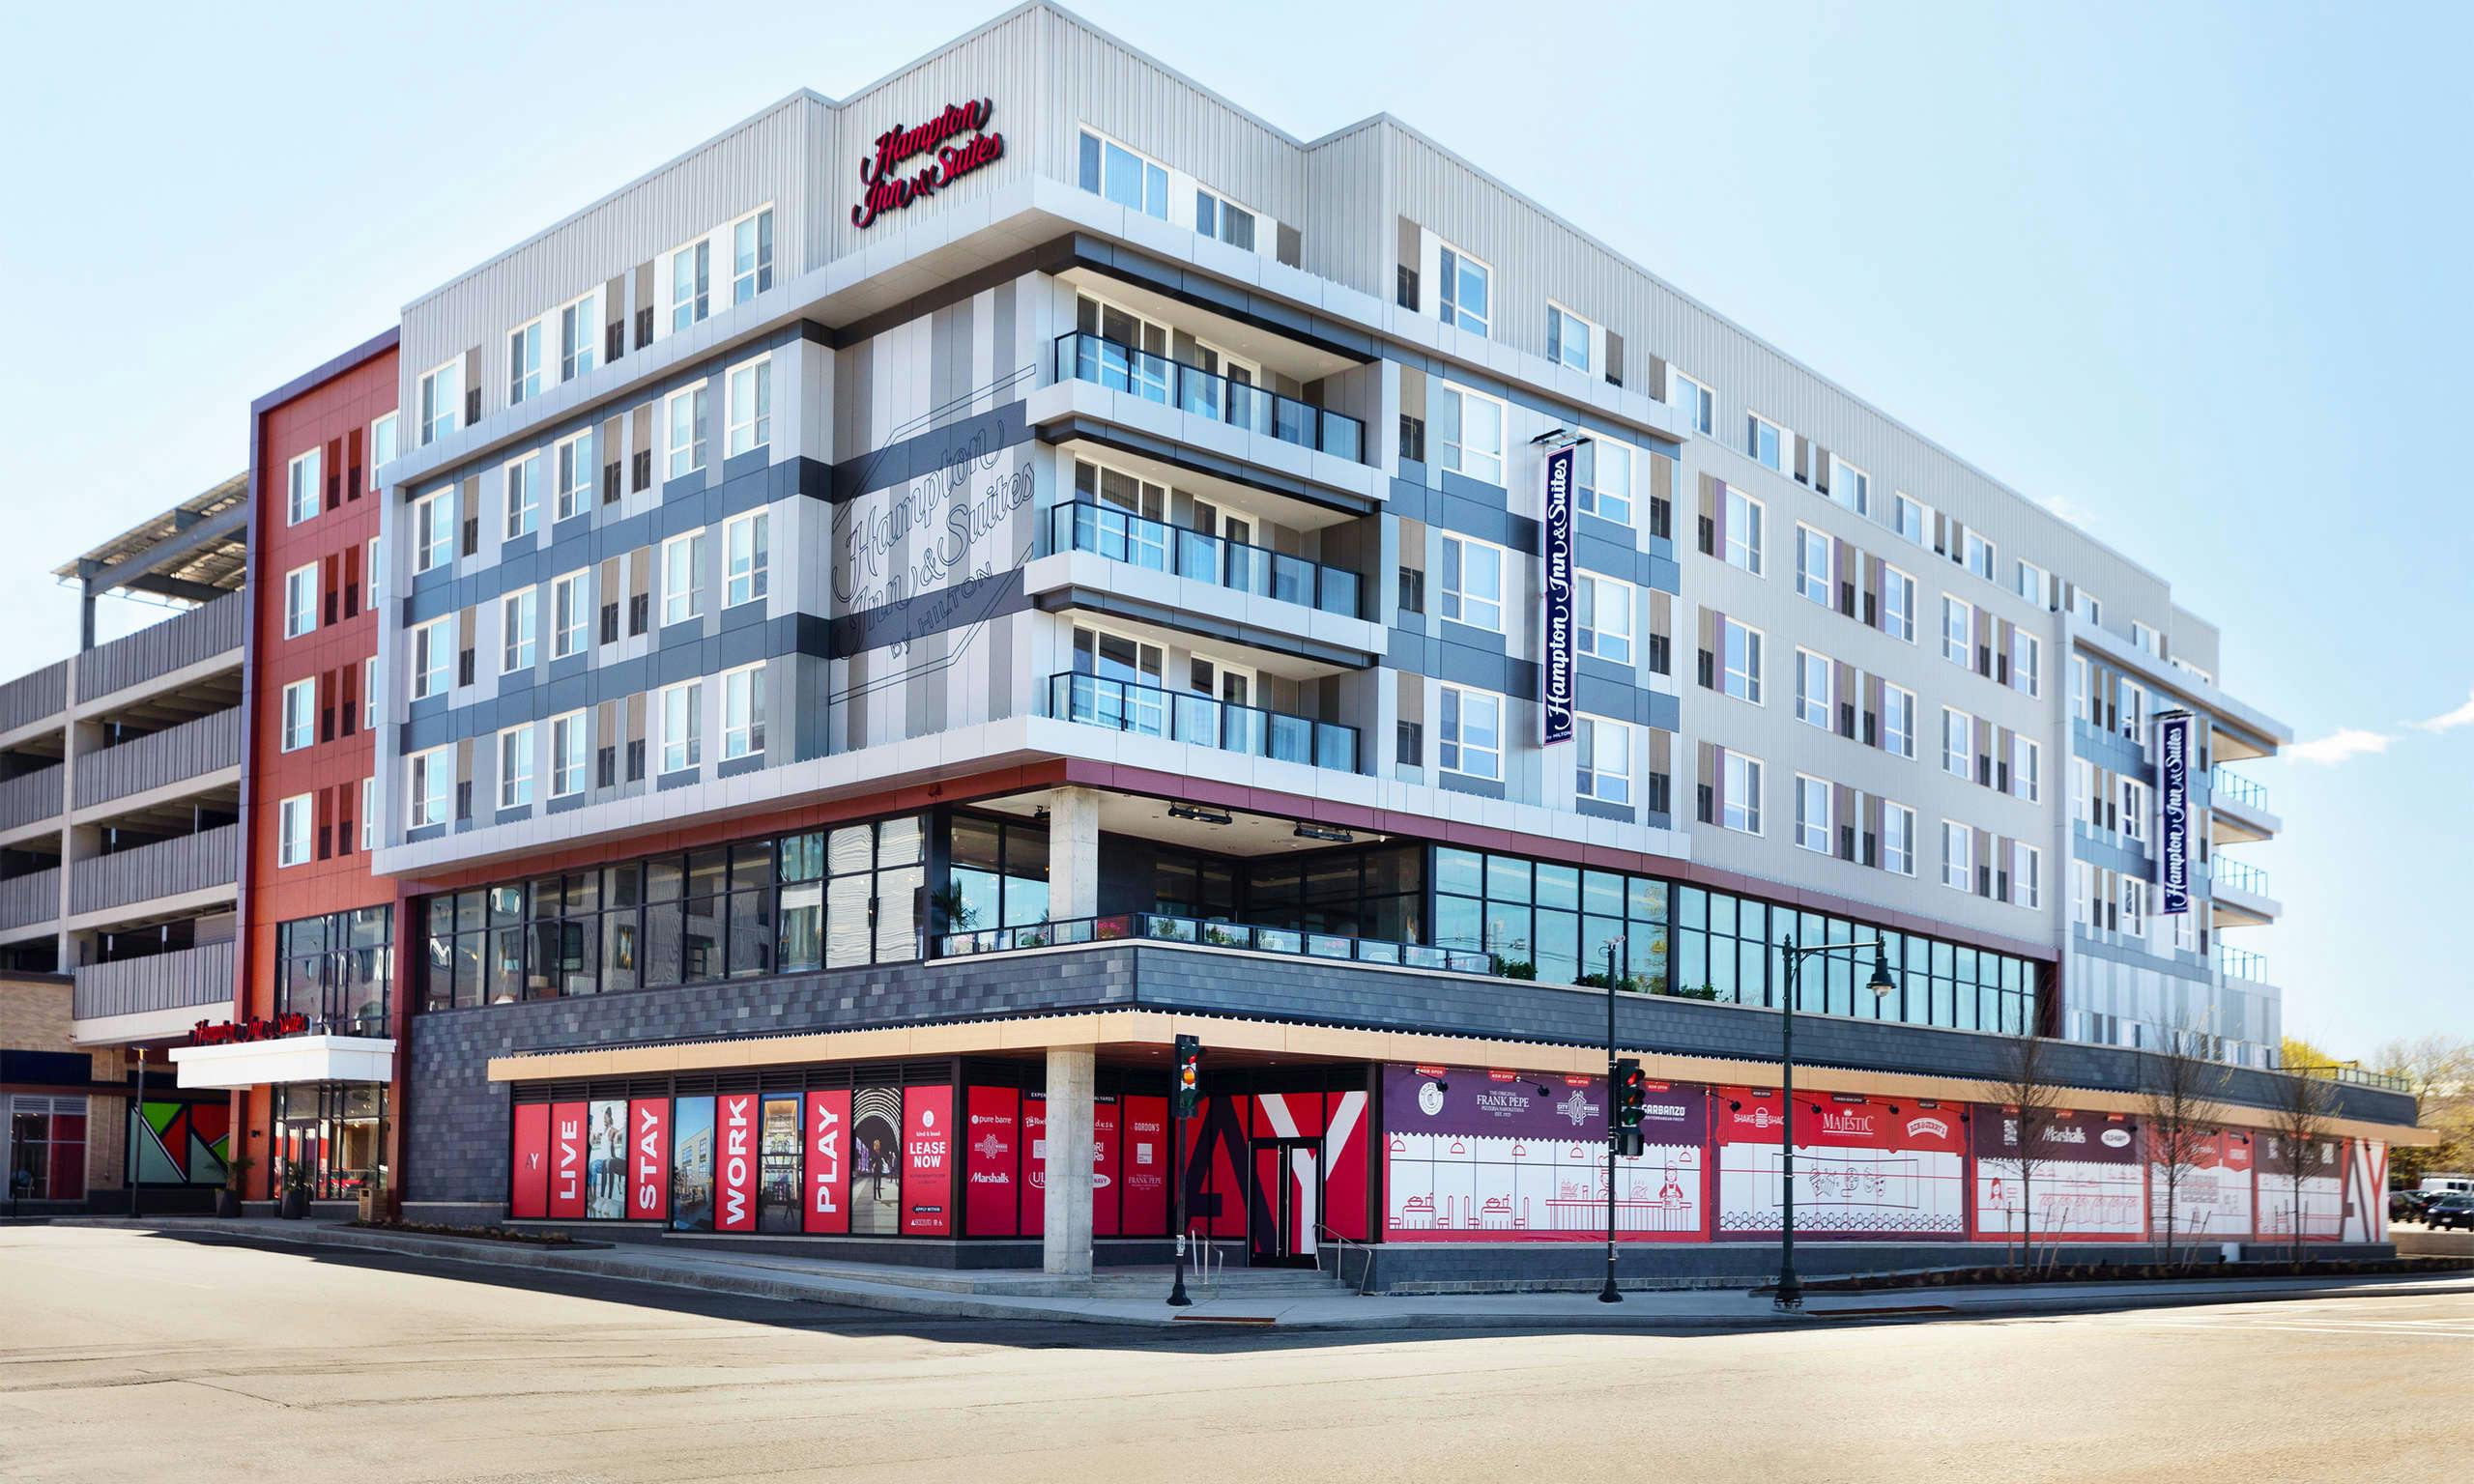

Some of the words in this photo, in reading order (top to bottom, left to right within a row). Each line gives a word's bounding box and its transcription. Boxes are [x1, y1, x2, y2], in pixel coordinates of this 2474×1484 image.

[860, 97, 992, 186] Hampton
[851, 176, 915, 228] Inn
[912, 168, 935, 196] &
[929, 131, 1004, 188] Suites
[832, 420, 1004, 603] Hampton
[1548, 458, 1568, 527] Suites
[835, 566, 917, 660] Inn
[920, 548, 945, 587] &
[937, 462, 1035, 566] Suites
[1553, 522, 1567, 540] &
[918, 561, 993, 637] HILTON
[1551, 541, 1569, 602] Inn
[1547, 606, 1571, 730] Hampton
[2166, 728, 2183, 775] Suites
[2167, 782, 2185, 822] Inn
[2165, 824, 2187, 906] Hampton
[994, 1115, 1012, 1125] barre
[1134, 1123, 1160, 1131] GORDON'S
[1477, 1095, 1508, 1106] FRANK
[1509, 1097, 1530, 1108] PEPE
[1641, 1104, 1685, 1117] GARBANZO
[1734, 1113, 1755, 1124] SHAKE
[1769, 1115, 1785, 1126] SHAC
[1823, 1113, 1874, 1131] MAJESTIC
[560, 1121, 577, 1199] LIVE
[639, 1108, 658, 1210] STAY
[727, 1098, 748, 1225] WORK
[817, 1104, 839, 1213] PLAY
[909, 1141, 946, 1155] LEASE
[913, 1155, 941, 1168] NOW
[970, 1172, 1010, 1184] Marshalls
